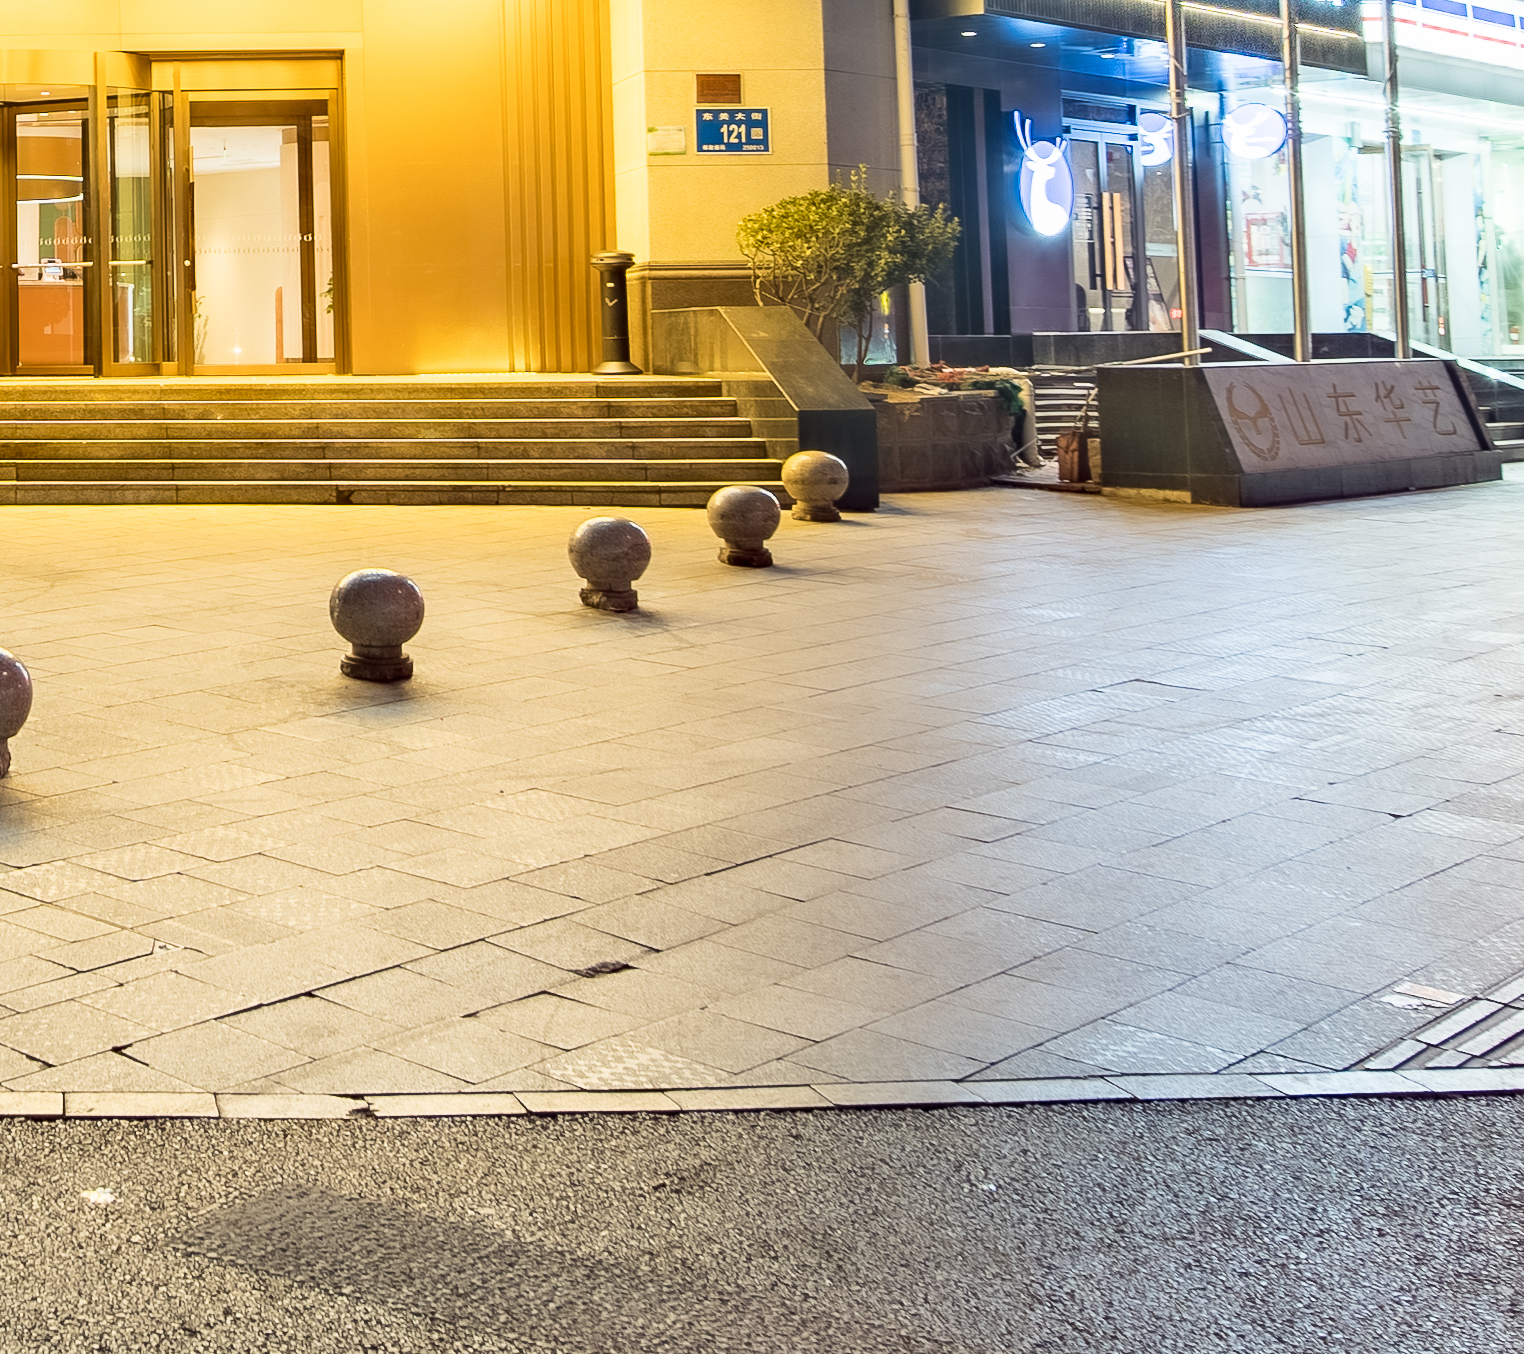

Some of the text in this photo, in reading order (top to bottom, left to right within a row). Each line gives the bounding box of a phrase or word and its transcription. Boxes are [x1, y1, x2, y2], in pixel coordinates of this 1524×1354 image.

[720, 124, 746, 143] 121
[1278, 379, 1457, 446] 山东华艺
